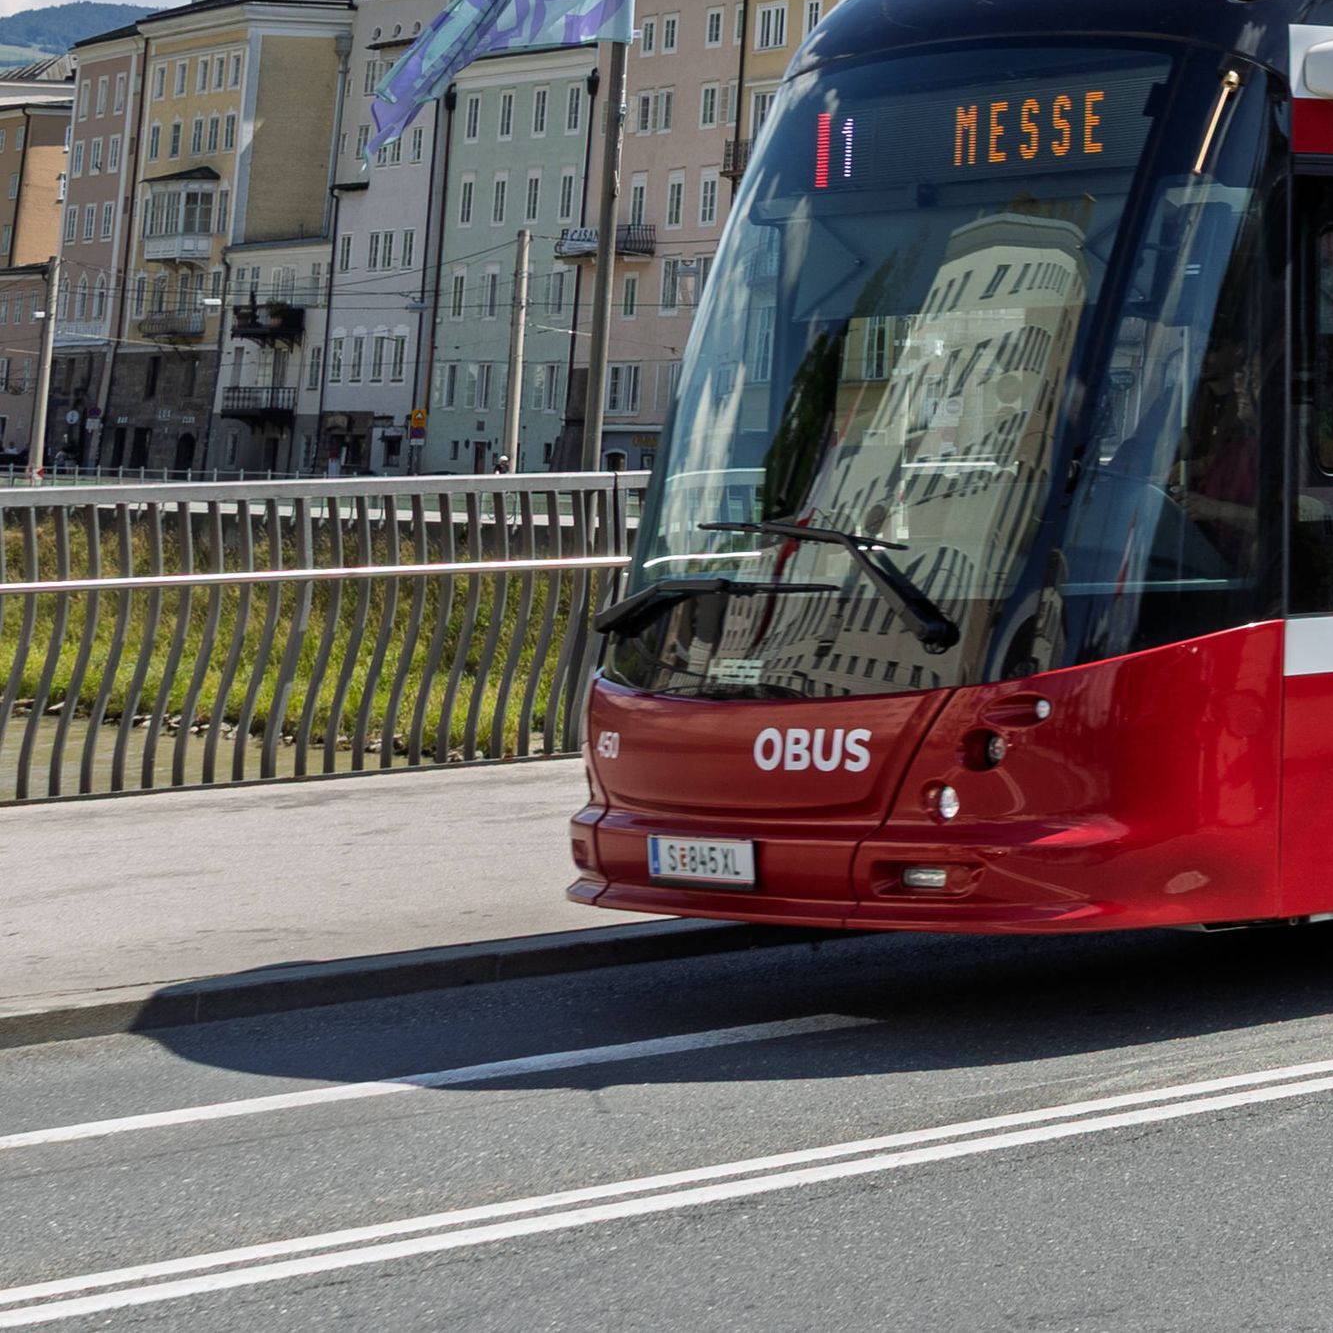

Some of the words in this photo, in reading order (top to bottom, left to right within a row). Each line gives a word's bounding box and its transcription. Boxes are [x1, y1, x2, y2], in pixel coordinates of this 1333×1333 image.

[841, 118, 854, 177] 1
[953, 91, 1105, 166] MESSE
[597, 730, 620, 759] 450
[753, 728, 873, 773] OBUS
